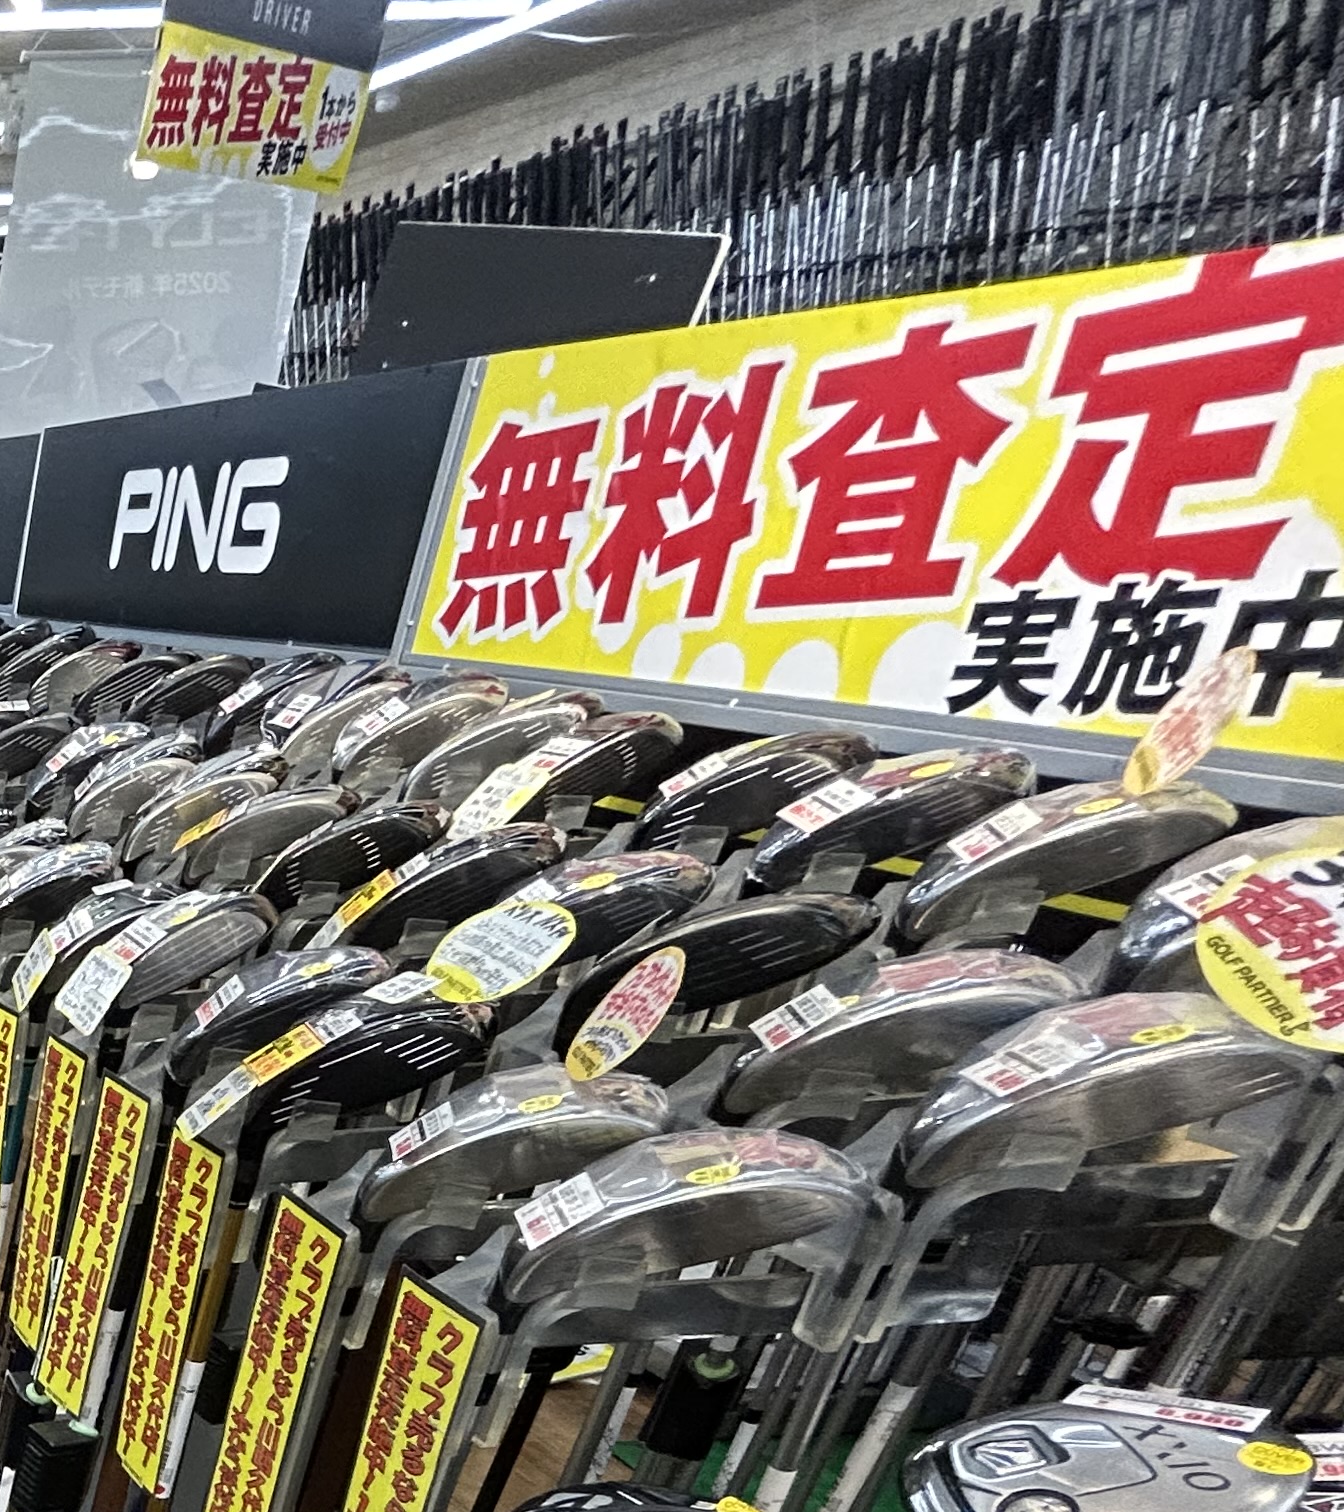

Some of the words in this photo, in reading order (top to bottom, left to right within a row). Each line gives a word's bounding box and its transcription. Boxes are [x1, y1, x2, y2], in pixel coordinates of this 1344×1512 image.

[146, 54, 314, 149] 無料査定
[313, 120, 352, 152] 受付中
[318, 86, 357, 121] 1本から
[256, 139, 308, 177] 実施中
[437, 244, 1344, 640] 無料査定
[110, 455, 290, 575] PING
[947, 571, 1344, 719] 実施中
[1205, 935, 1240, 966] GOLF
[1235, 964, 1295, 1025] PARTNER
